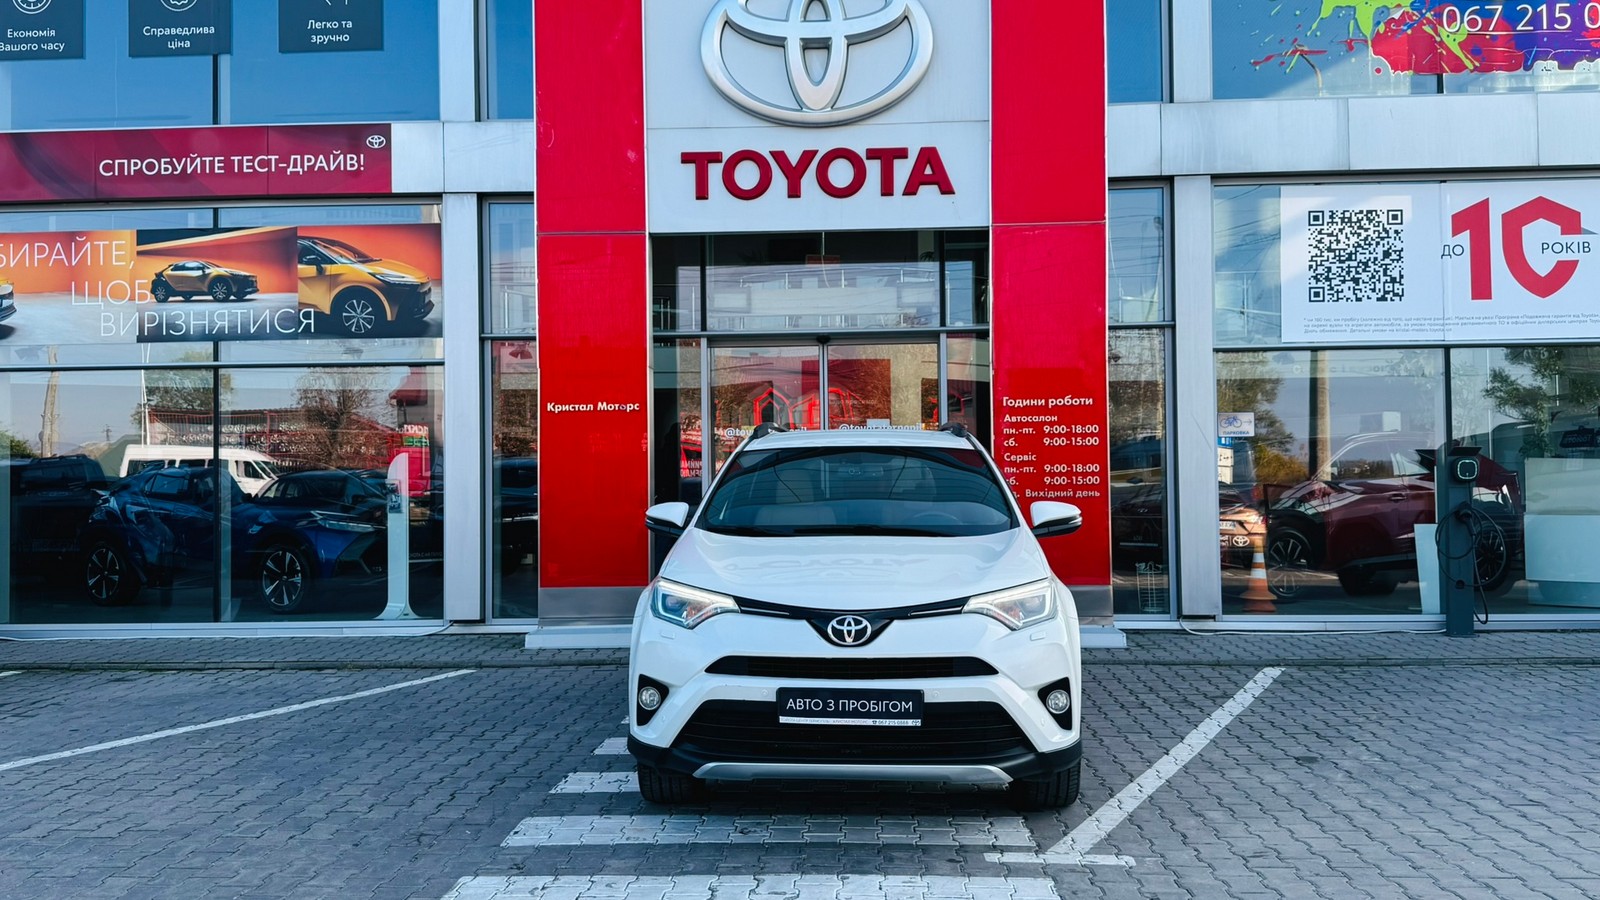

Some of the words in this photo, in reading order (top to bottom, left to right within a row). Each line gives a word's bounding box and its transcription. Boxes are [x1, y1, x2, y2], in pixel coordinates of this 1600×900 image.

[1442, 5, 1503, 33] 067
[1516, 3, 1572, 31] 215
[307, 19, 339, 30] Легко
[341, 20, 353, 29] та
[7, 28, 56, 38] Економія
[143, 25, 215, 37] Справедлива
[167, 38, 191, 50] ціна
[310, 34, 350, 45] зручно
[0, 42, 38, 52] Вашого
[41, 42, 65, 52] часу
[99, 154, 225, 177] СПРОБУЙТЕ
[231, 150, 365, 175] ТЕСТ-ДРАЙВ!
[681, 146, 956, 200] TOYOTA
[1441, 244, 1465, 259] ДО
[1541, 241, 1592, 254] РОКІВ
[71, 279, 151, 309] ЩОБ
[100, 307, 316, 337] ВИРІЗНЯТИСЯ
[547, 402, 593, 413] Кристал
[597, 402, 640, 412] Моторс
[1002, 397, 1046, 408] Години
[1048, 395, 1093, 409] роботи
[1003, 414, 1058, 423] Автосалон
[1043, 424, 1099, 433] 9:00-18:00
[1003, 437, 1019, 447] сб.
[1043, 437, 1100, 446] 9:00-15:00
[1003, 452, 1037, 463] Сервіс
[1044, 464, 1100, 473] 9:00-18:00
[1006, 476, 1019, 485] б.
[1044, 476, 1100, 485] 9:00-15:00
[1025, 488, 1073, 498] Вихідний
[1075, 490, 1101, 498] день
[786, 698, 823, 711] АВТО
[839, 700, 913, 712] ПРОБІГОМ
